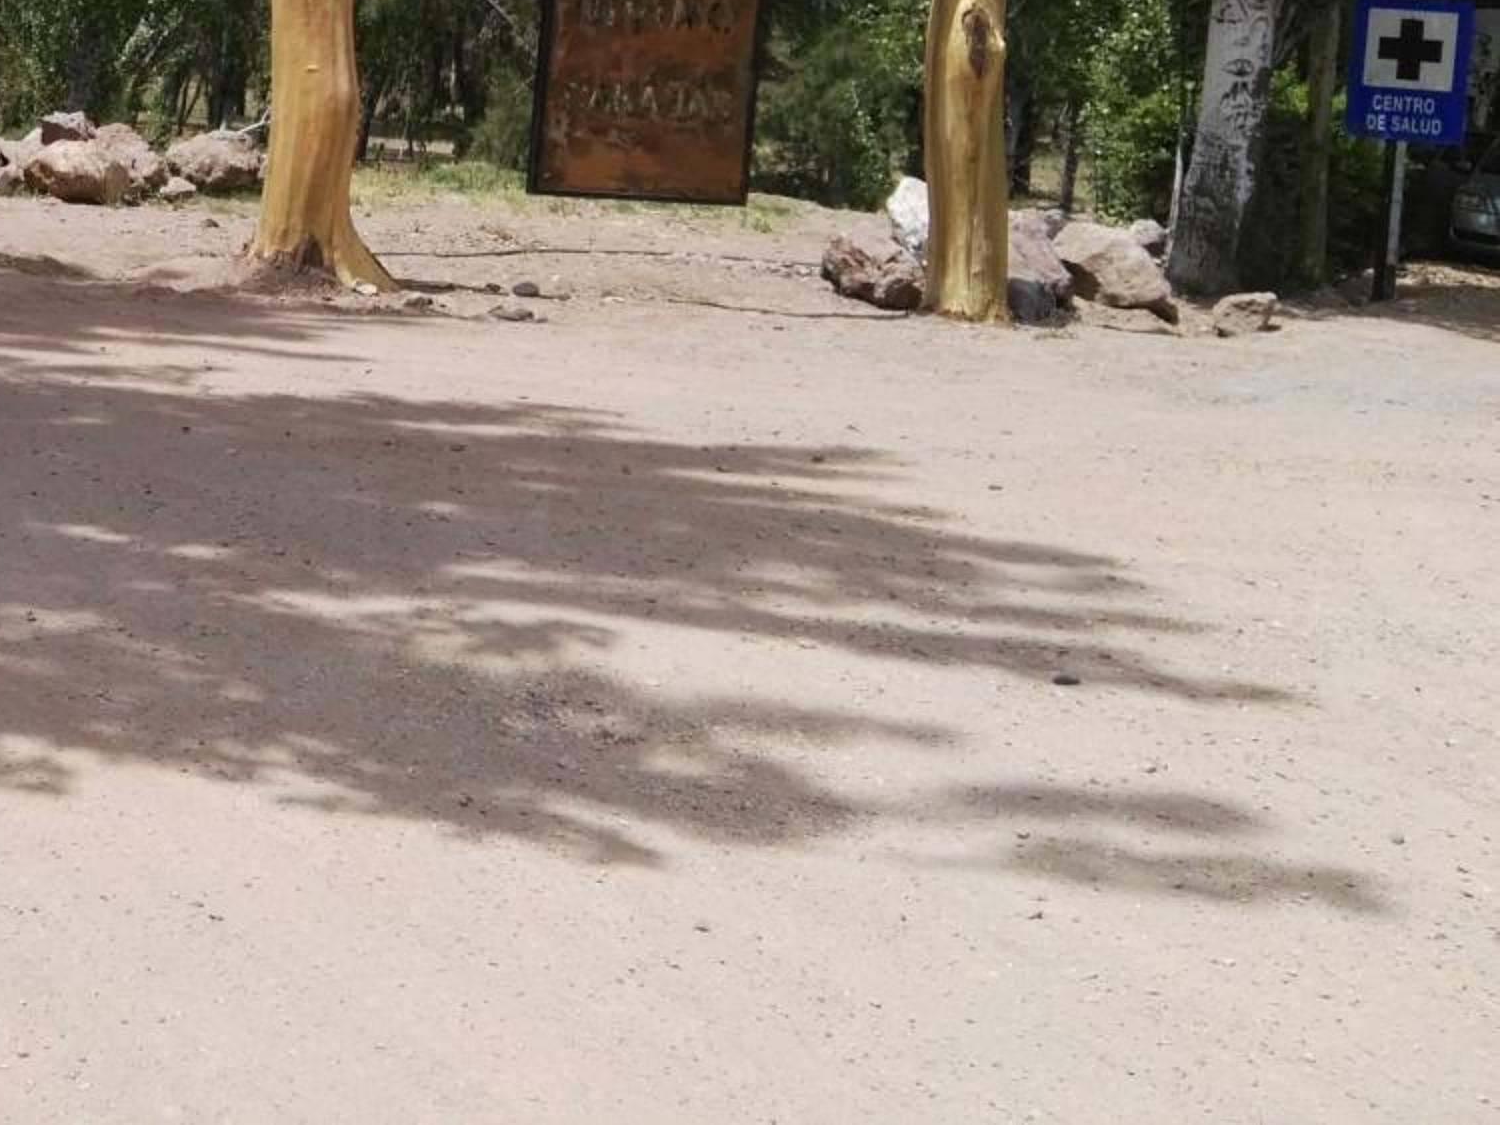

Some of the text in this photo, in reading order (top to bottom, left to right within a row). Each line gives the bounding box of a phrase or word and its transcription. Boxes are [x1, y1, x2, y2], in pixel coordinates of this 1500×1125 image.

[1373, 95, 1435, 114] CENTRO
[1367, 114, 1442, 135] DE SALUD
